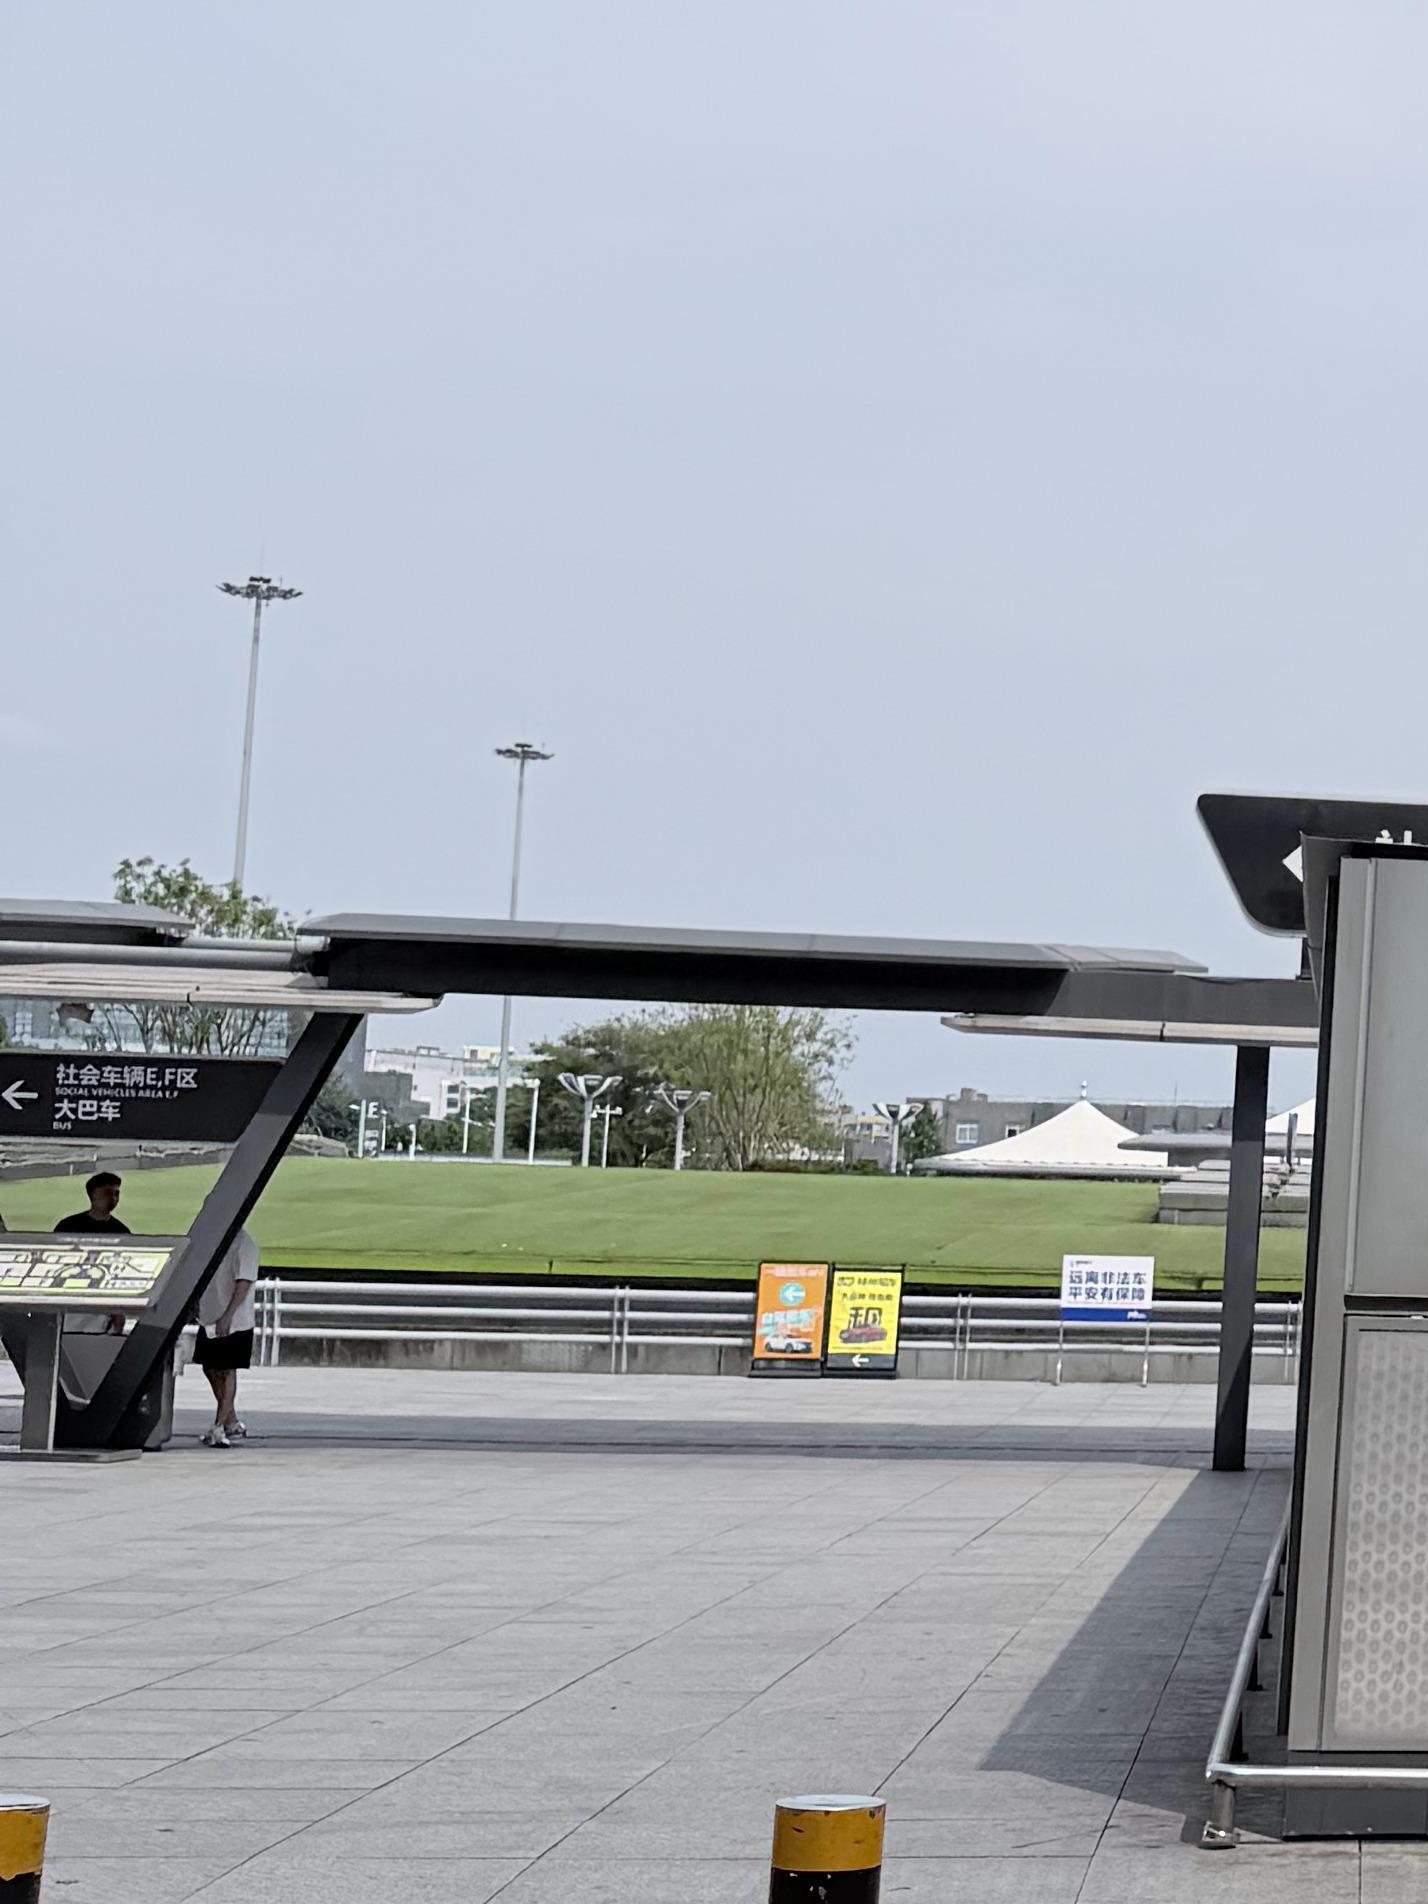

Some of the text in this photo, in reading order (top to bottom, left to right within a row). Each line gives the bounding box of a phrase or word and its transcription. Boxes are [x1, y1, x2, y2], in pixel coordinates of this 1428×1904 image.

[56, 1063, 198, 1089] 社会车辆E,F区
[55, 1087, 89, 1097] SOCIAL
[54, 1098, 121, 1122] 大巴车
[367, 1101, 380, 1119] E
